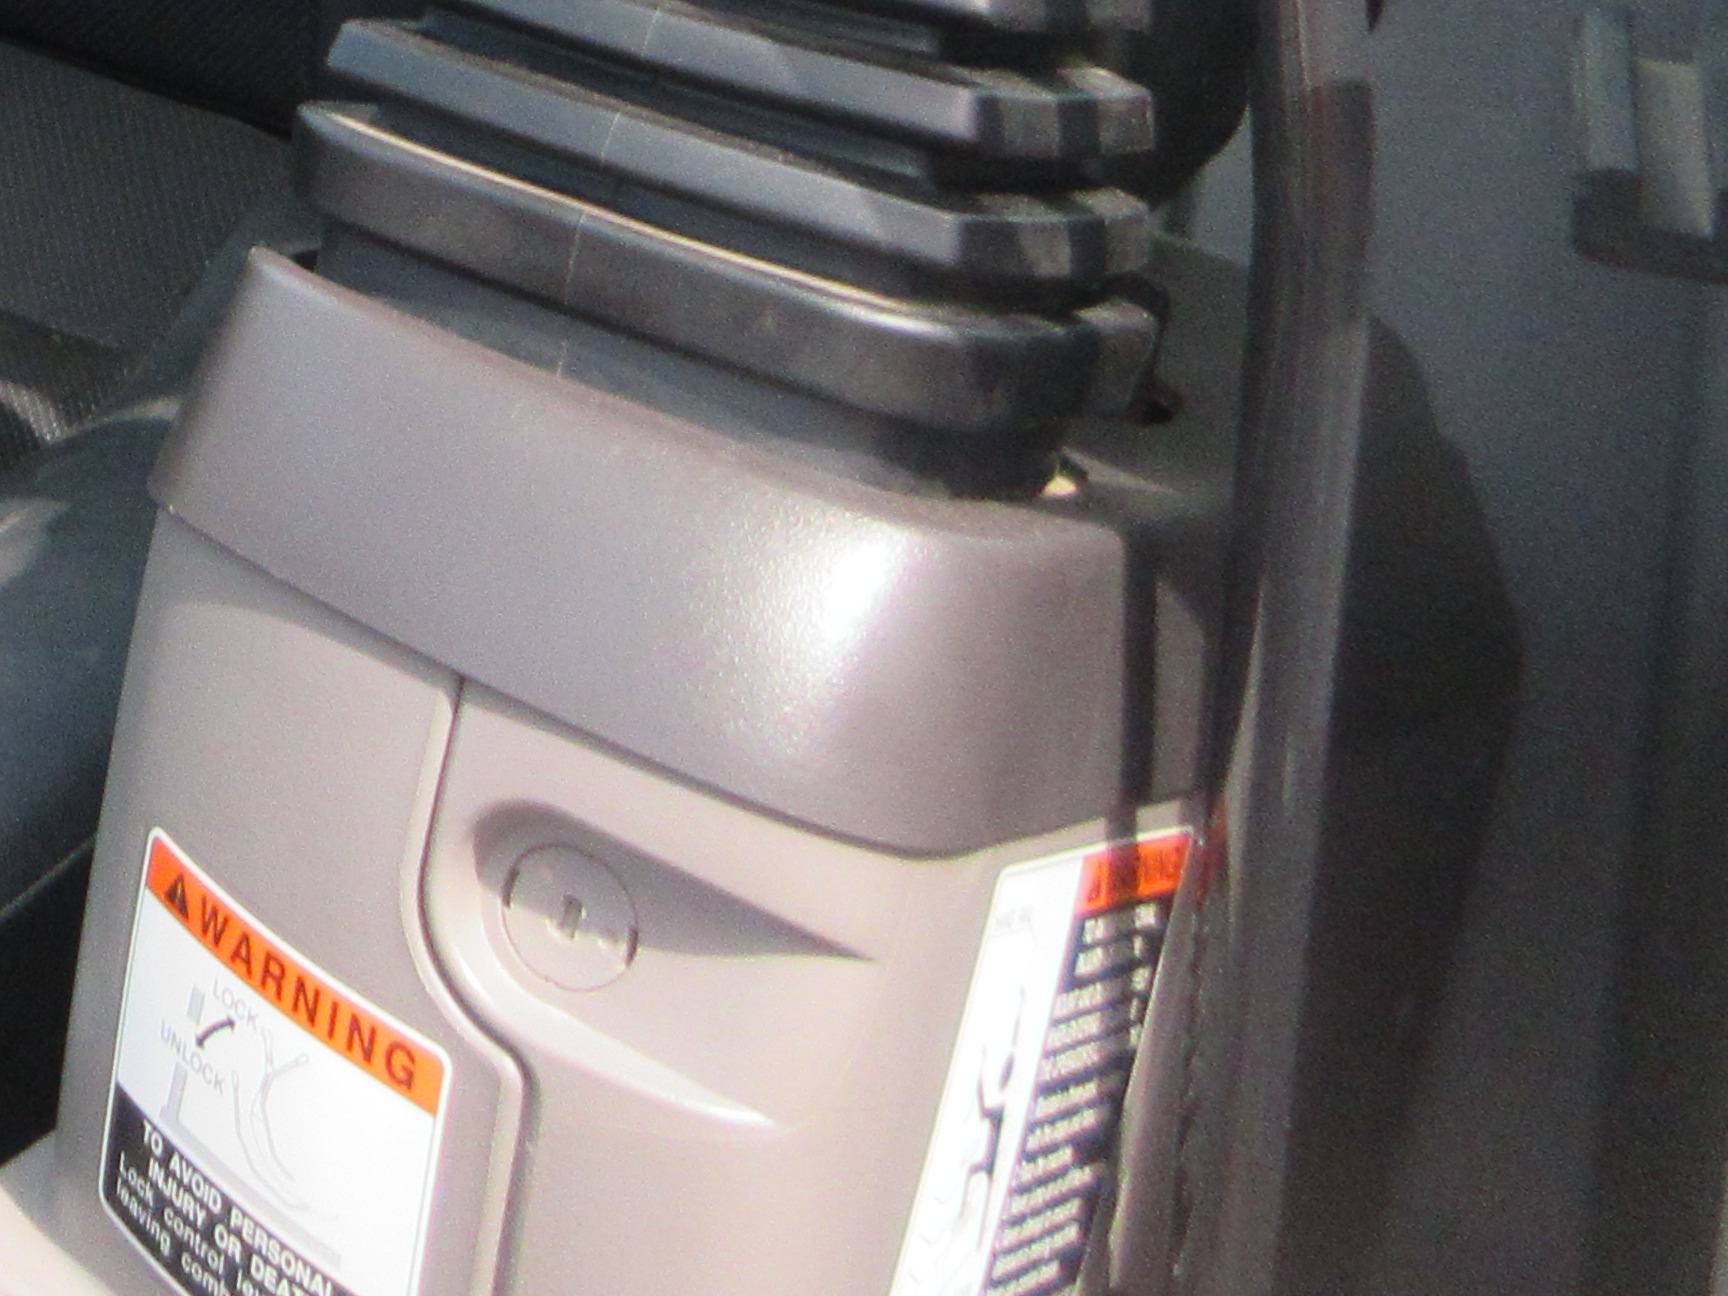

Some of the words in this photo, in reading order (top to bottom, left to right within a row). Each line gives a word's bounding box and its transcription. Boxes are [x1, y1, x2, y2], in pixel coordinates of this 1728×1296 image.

[200, 892, 416, 1091] WARNING
[213, 977, 258, 1032] LOCK
[160, 1018, 224, 1096] UNLOCK
[119, 1149, 155, 1207] Lock
[163, 1206, 226, 1275] control
[142, 1119, 164, 1156] TO
[168, 1151, 222, 1214] AVOID
[148, 1157, 208, 1229] INJURY
[213, 1222, 243, 1264] OR
[115, 1176, 171, 1257] leaving
